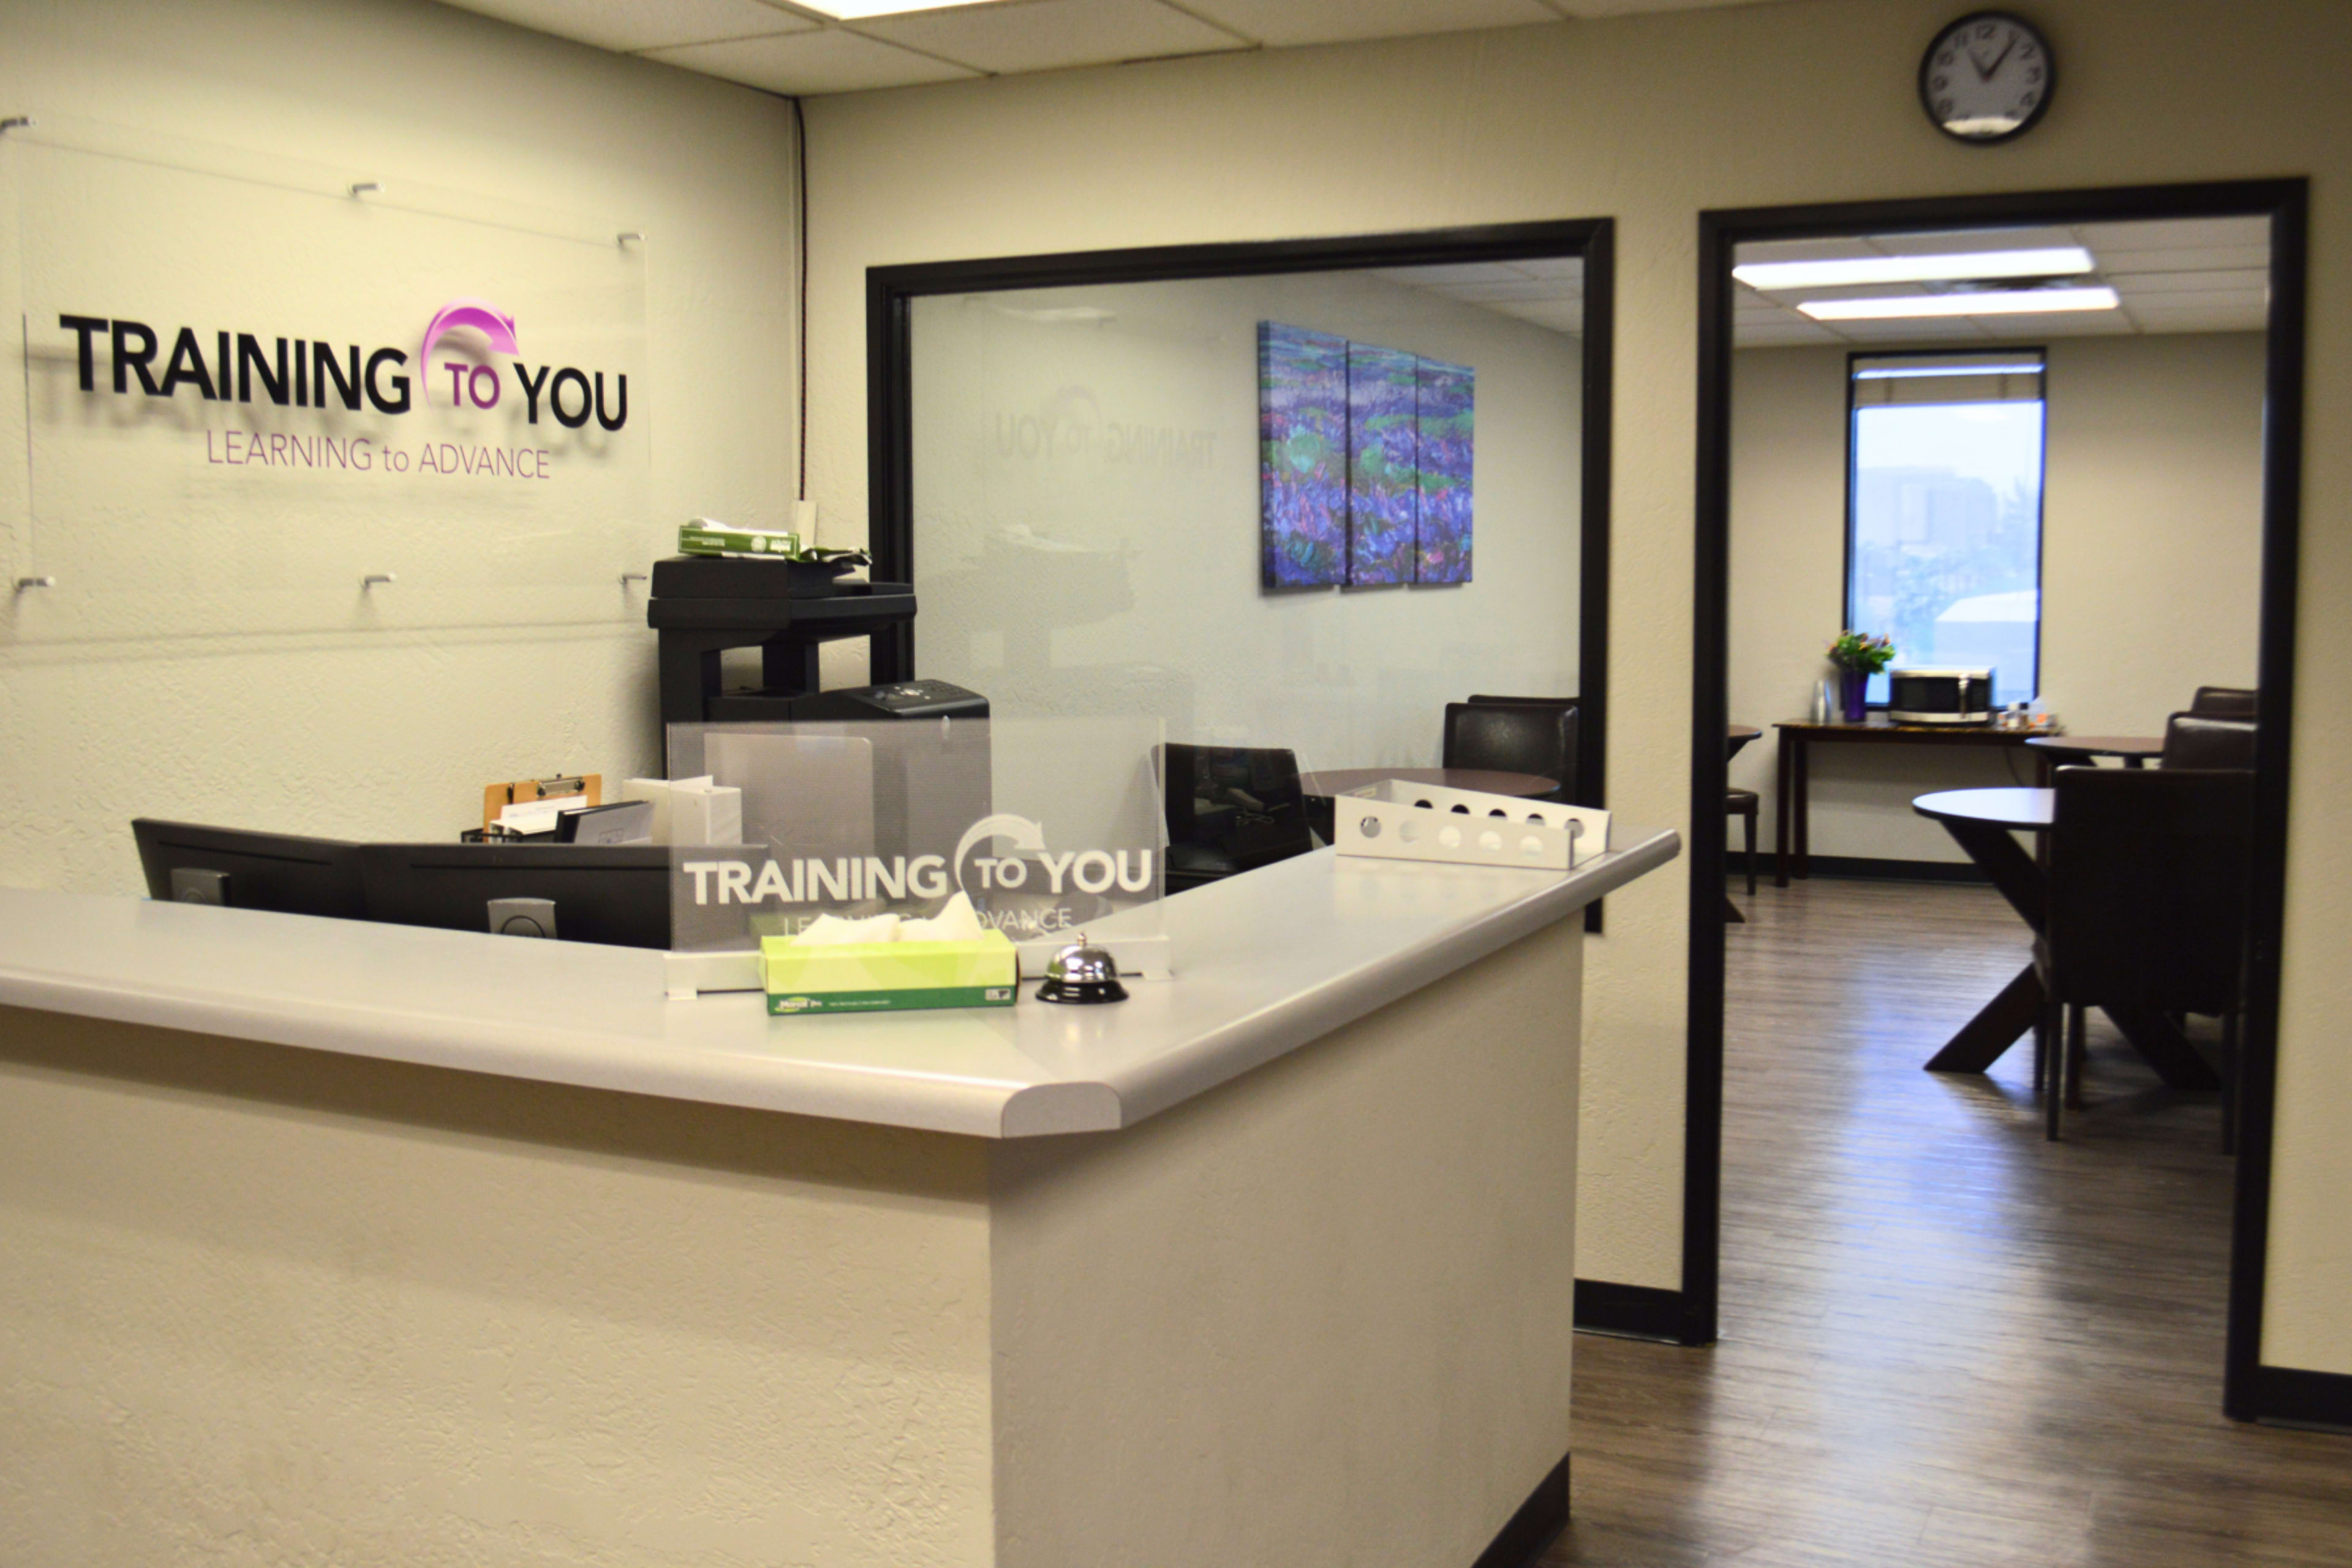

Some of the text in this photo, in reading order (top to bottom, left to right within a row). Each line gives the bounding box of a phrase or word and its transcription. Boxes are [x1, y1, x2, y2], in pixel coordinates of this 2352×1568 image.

[2021, 43, 2034, 59] 2
[2026, 67, 2041, 84] 3
[59, 314, 628, 431] TRAINING TO YOU
[207, 429, 549, 479] LEARNING to ADVANCE
[683, 849, 1152, 905] TRAINING TO YOU
[975, 908, 1072, 930] DVANCE
